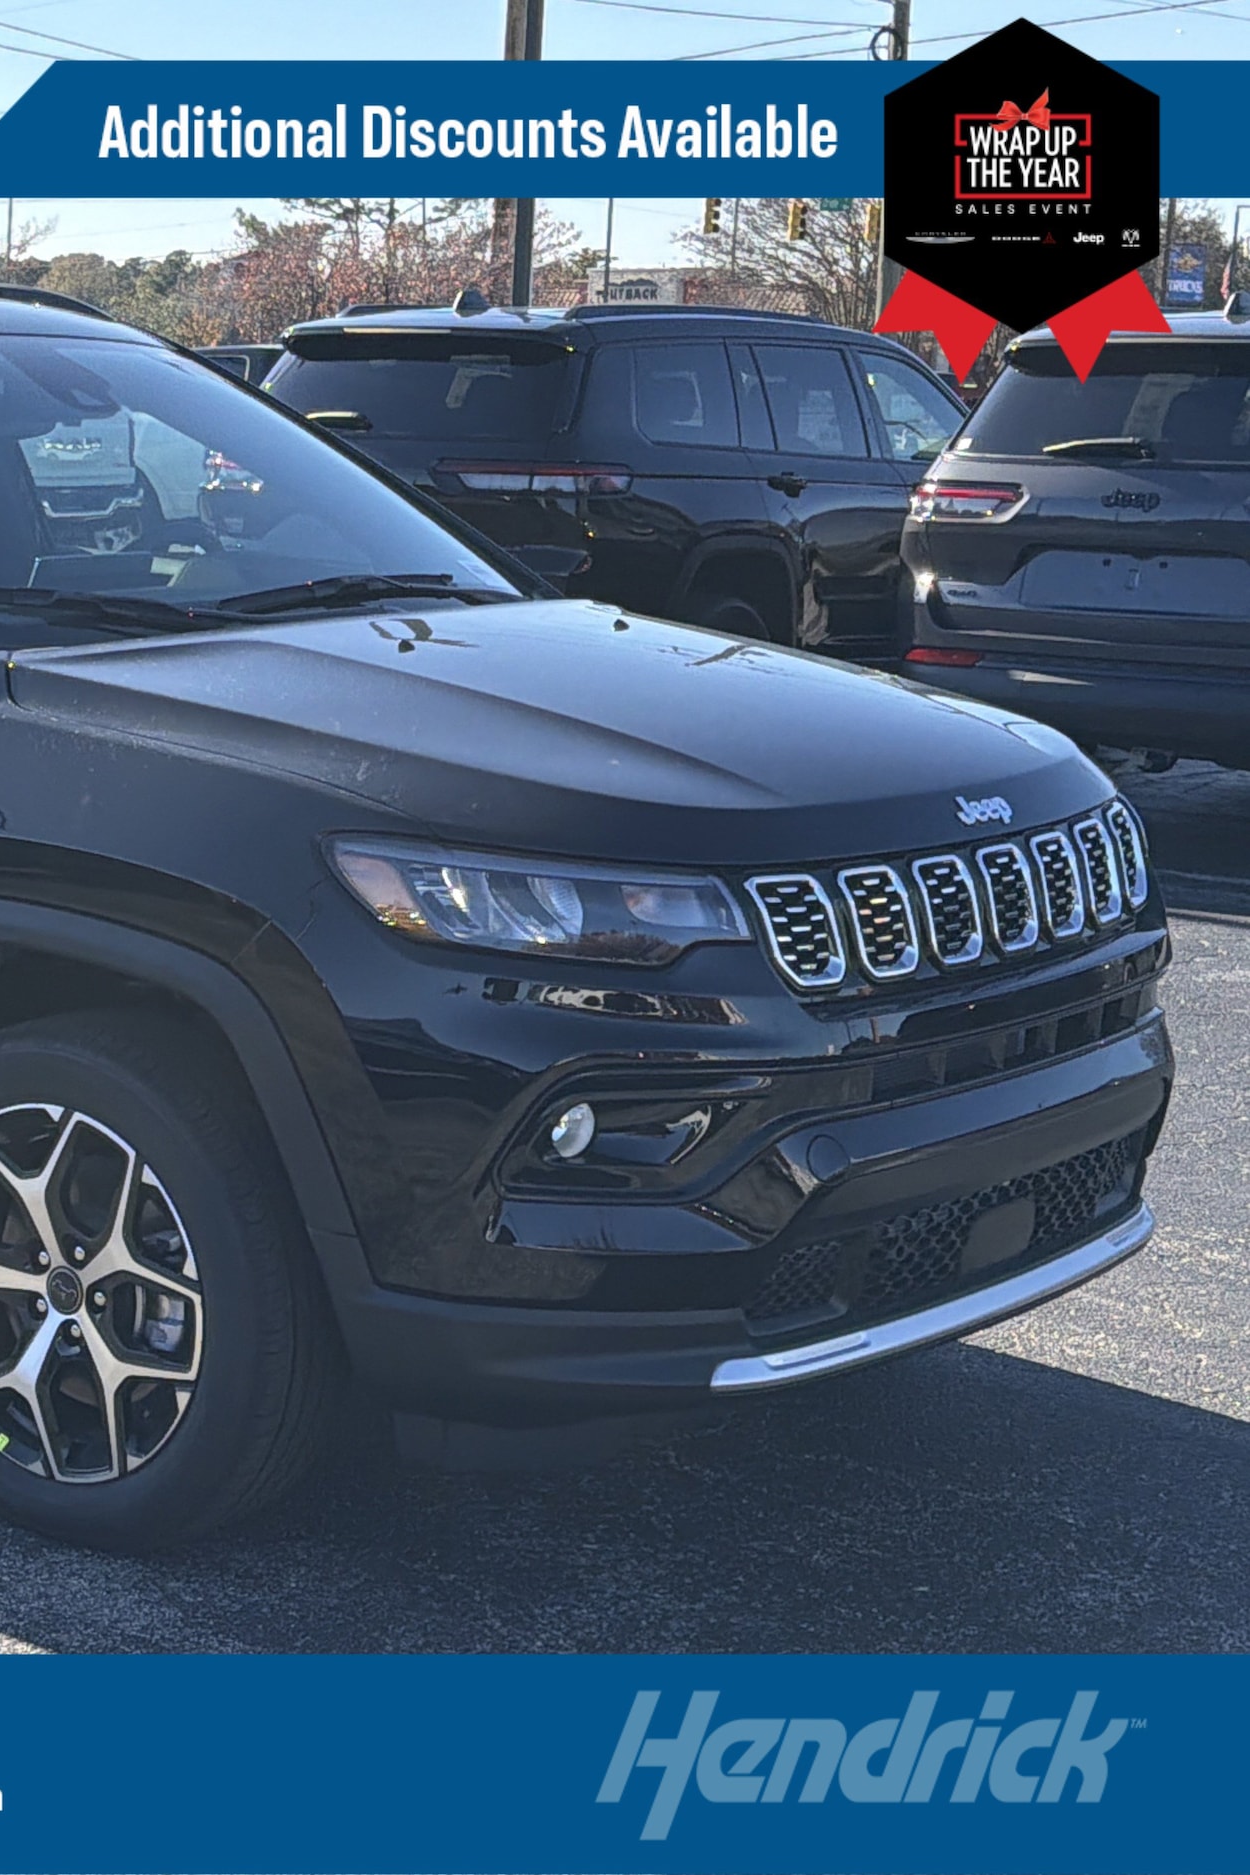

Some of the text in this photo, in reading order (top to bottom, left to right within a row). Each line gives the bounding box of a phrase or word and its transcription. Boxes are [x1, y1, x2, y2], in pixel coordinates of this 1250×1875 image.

[607, 288, 658, 300] UTBACK
[1101, 488, 1160, 513] Jeep
[954, 796, 1013, 825] Jeep
